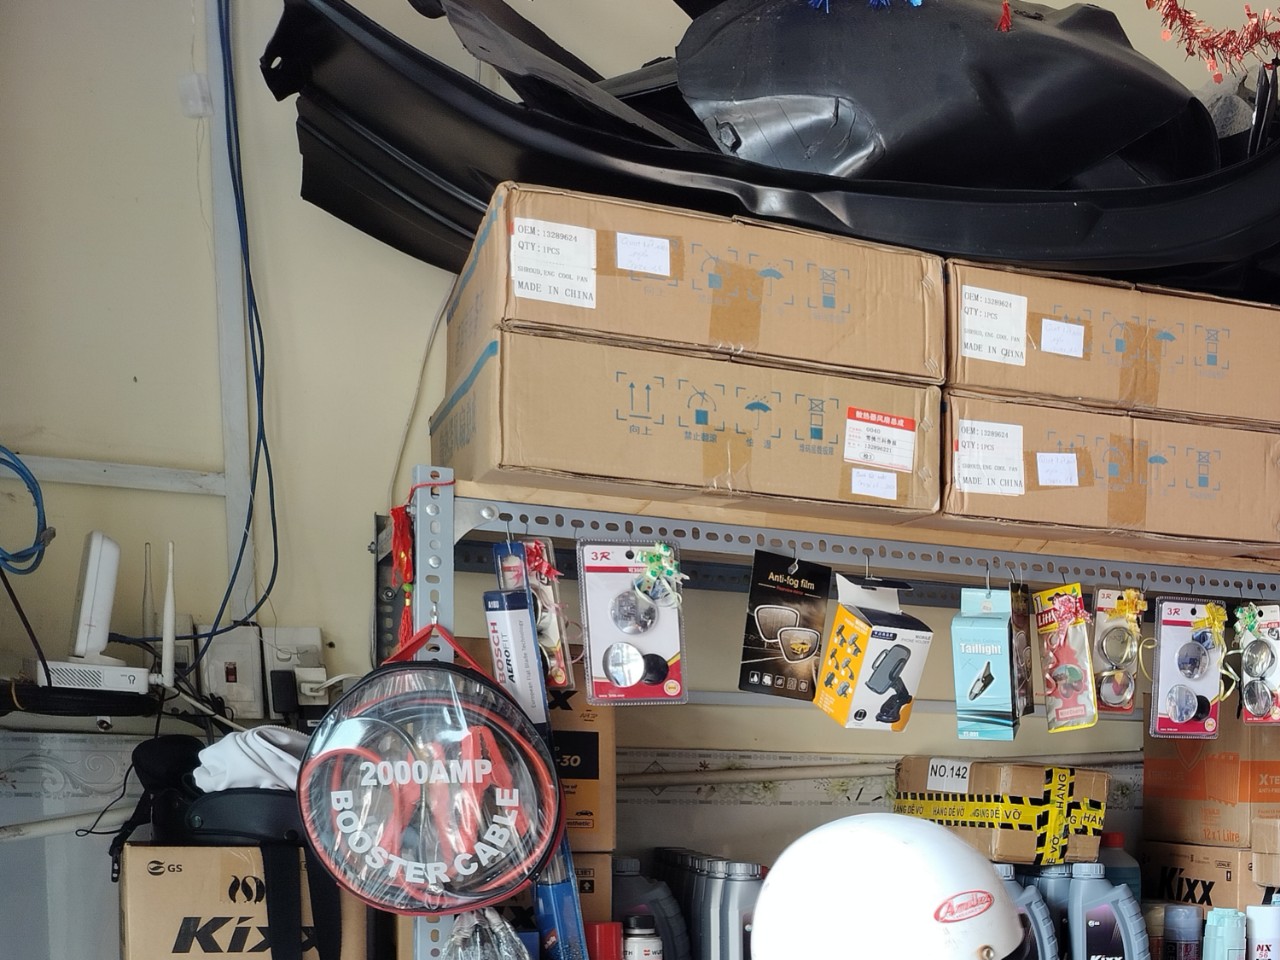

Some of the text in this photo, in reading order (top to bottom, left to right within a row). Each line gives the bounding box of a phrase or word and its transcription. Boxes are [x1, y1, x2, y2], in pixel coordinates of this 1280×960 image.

[517, 280, 594, 302] MADE IN CHINA
[963, 341, 1024, 360] MADE IN CHINA
[629, 424, 653, 437] 向上
[962, 475, 1023, 488] MADE IN CHINA
[591, 551, 611, 562] 3R
[768, 571, 815, 590] Anti-fog film
[1167, 607, 1181, 616] 3R
[490, 622, 506, 684] BOSCH
[959, 642, 1002, 656] Taillight
[501, 633, 516, 684] AEROFIT
[360, 758, 493, 787] 2000AMP
[929, 764, 968, 780] NO.142
[1056, 773, 1067, 809] HÀNG
[1004, 808, 1021, 820] VỠ
[331, 787, 519, 885] BOOSTER CABLE
[1202, 827, 1211, 840] 12
[1222, 829, 1240, 843] Litre
[167, 864, 183, 873] GS
[1159, 866, 1215, 906] Kixx
[1256, 944, 1272, 952] NX
